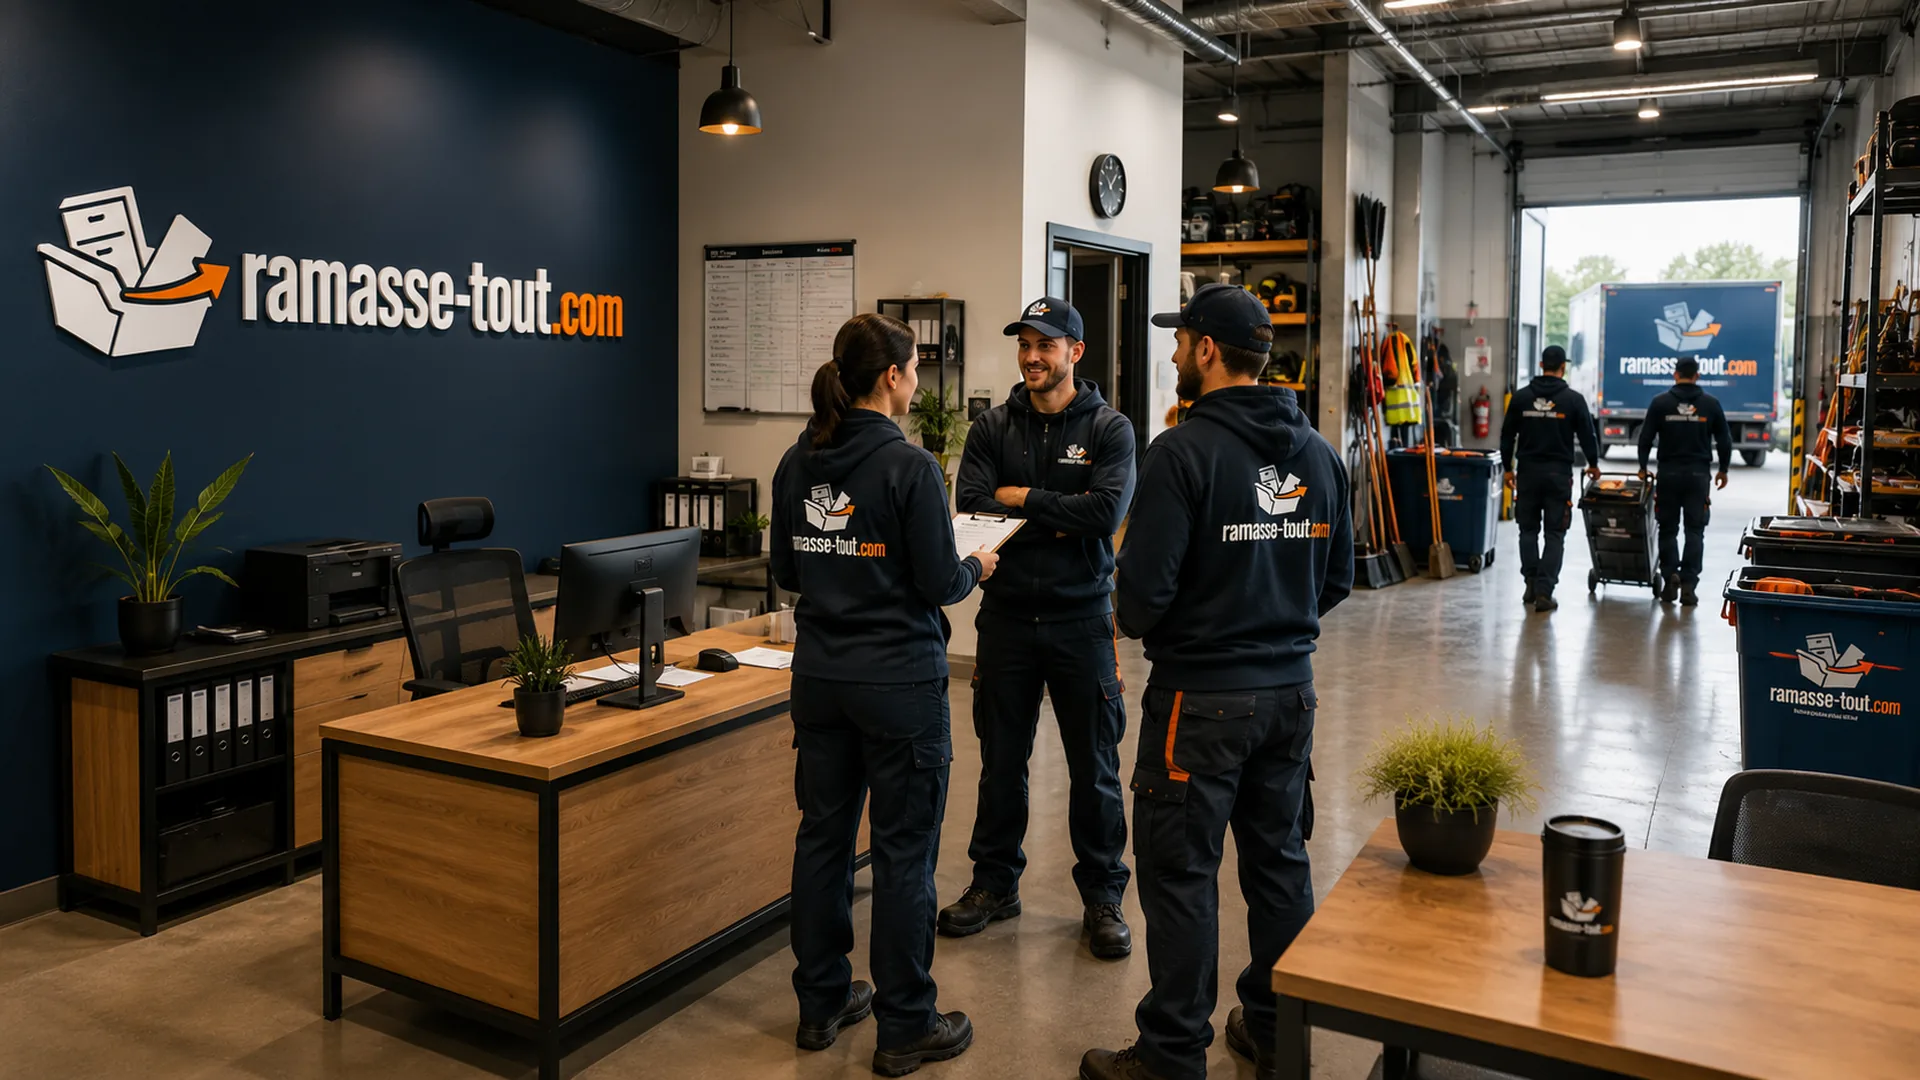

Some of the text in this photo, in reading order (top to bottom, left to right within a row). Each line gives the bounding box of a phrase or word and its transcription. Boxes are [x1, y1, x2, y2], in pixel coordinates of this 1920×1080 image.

[241, 252, 623, 337] ramasse-tout.com
[1619, 354, 1757, 376] ramassout.com
[1770, 687, 1901, 715] ramasse-tout.com
